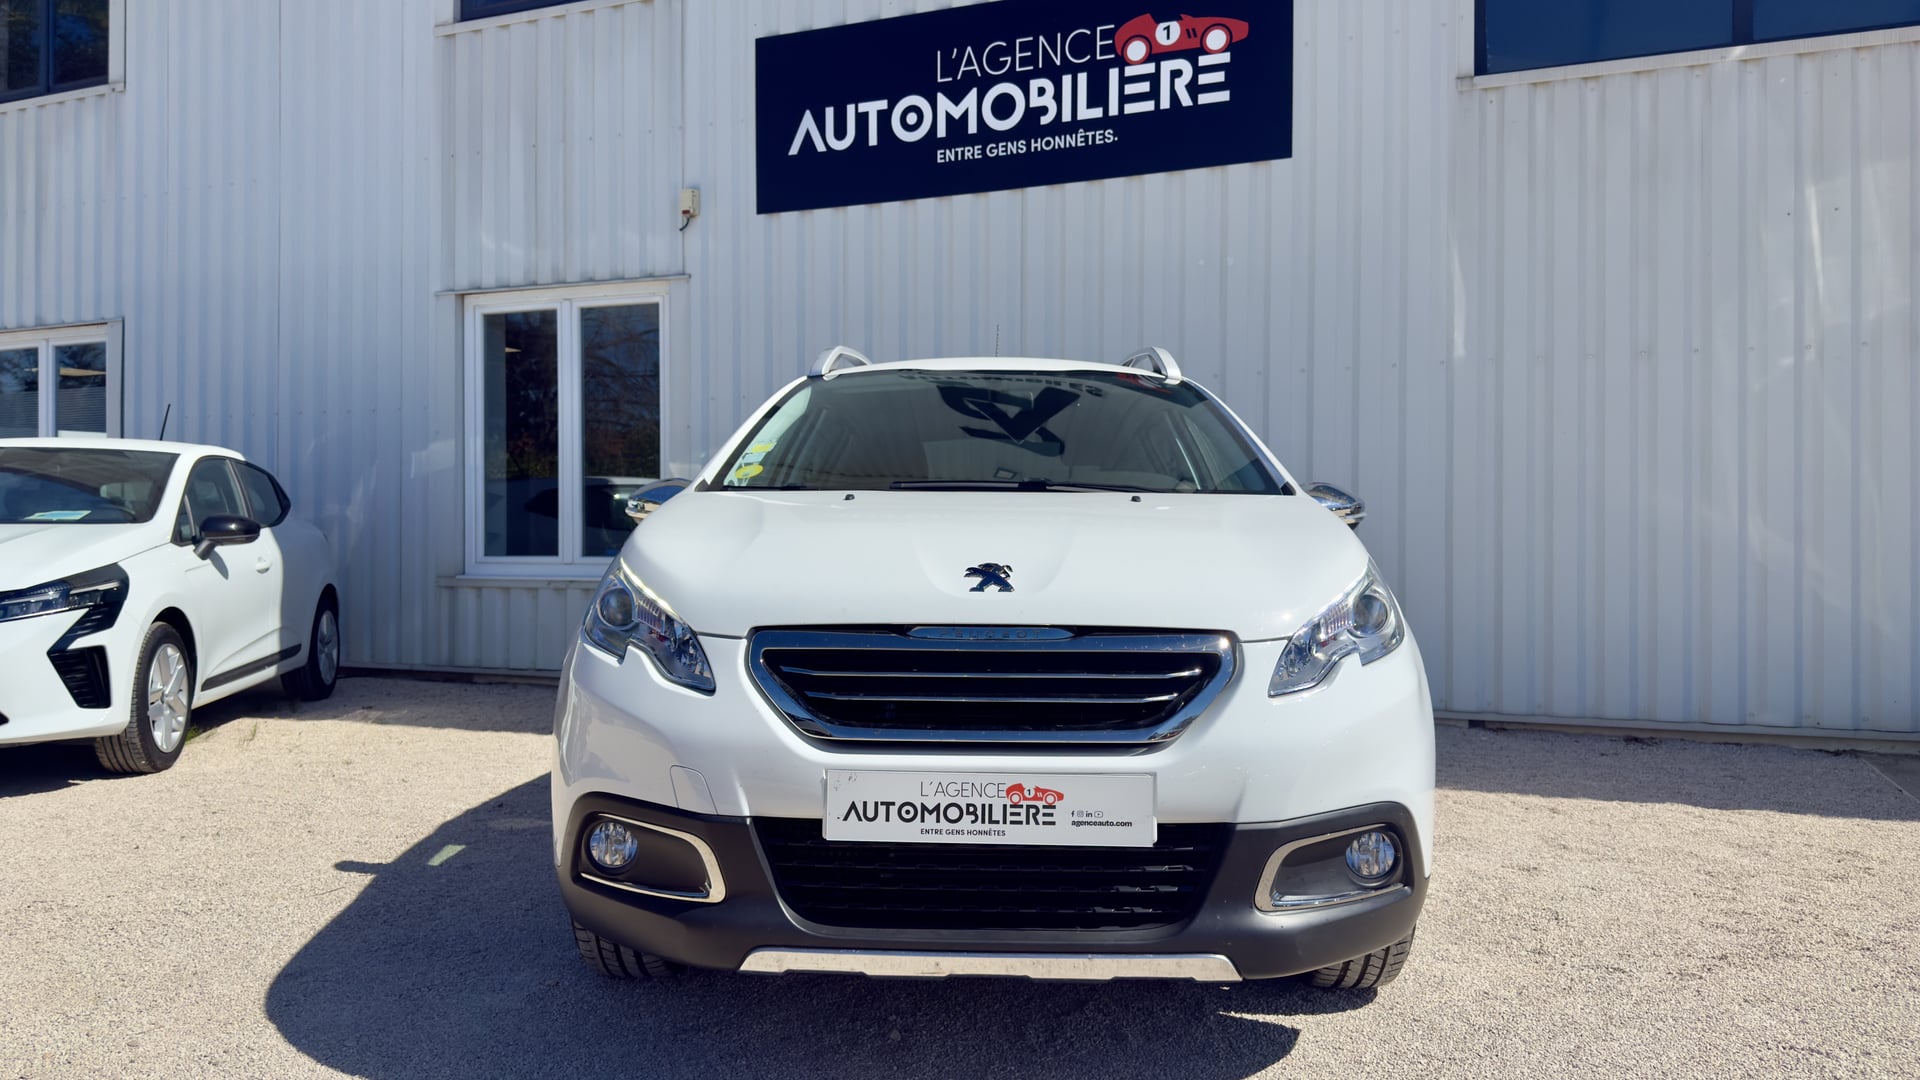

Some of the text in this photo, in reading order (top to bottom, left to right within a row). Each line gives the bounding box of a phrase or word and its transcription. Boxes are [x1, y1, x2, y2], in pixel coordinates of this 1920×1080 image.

[936, 24, 1115, 83] L'AGENCE
[937, 129, 1119, 163] ENTRE GENS HONNÊTES.
[920, 781, 1006, 798] L'AGENCE
[945, 828, 966, 836] GENS
[967, 828, 1006, 837] HONNÊTES
[1071, 820, 1132, 828] agenceauto.com
